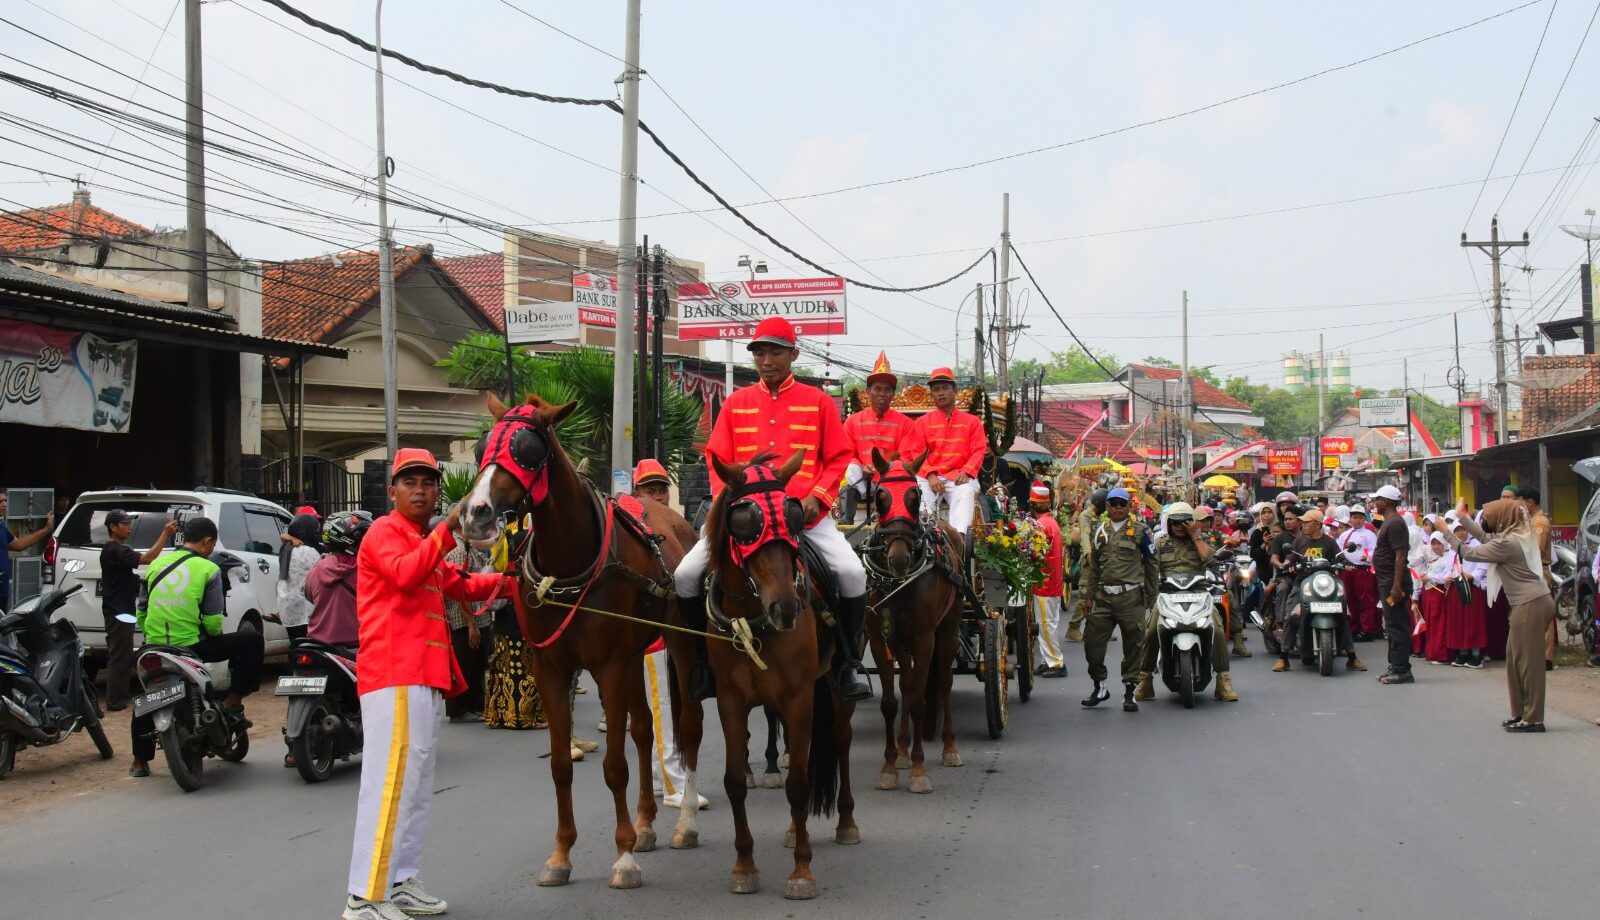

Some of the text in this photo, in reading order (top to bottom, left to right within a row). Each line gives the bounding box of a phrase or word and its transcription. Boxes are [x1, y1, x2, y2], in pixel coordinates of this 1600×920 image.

[576, 291, 600, 305] BANK
[684, 304, 727, 318] BANK
[730, 302, 780, 316] SURYA
[508, 310, 548, 324] Dabe
[582, 312, 610, 322] KANTOR
[720, 328, 744, 336] KAS
[147, 690, 166, 702] 5027
